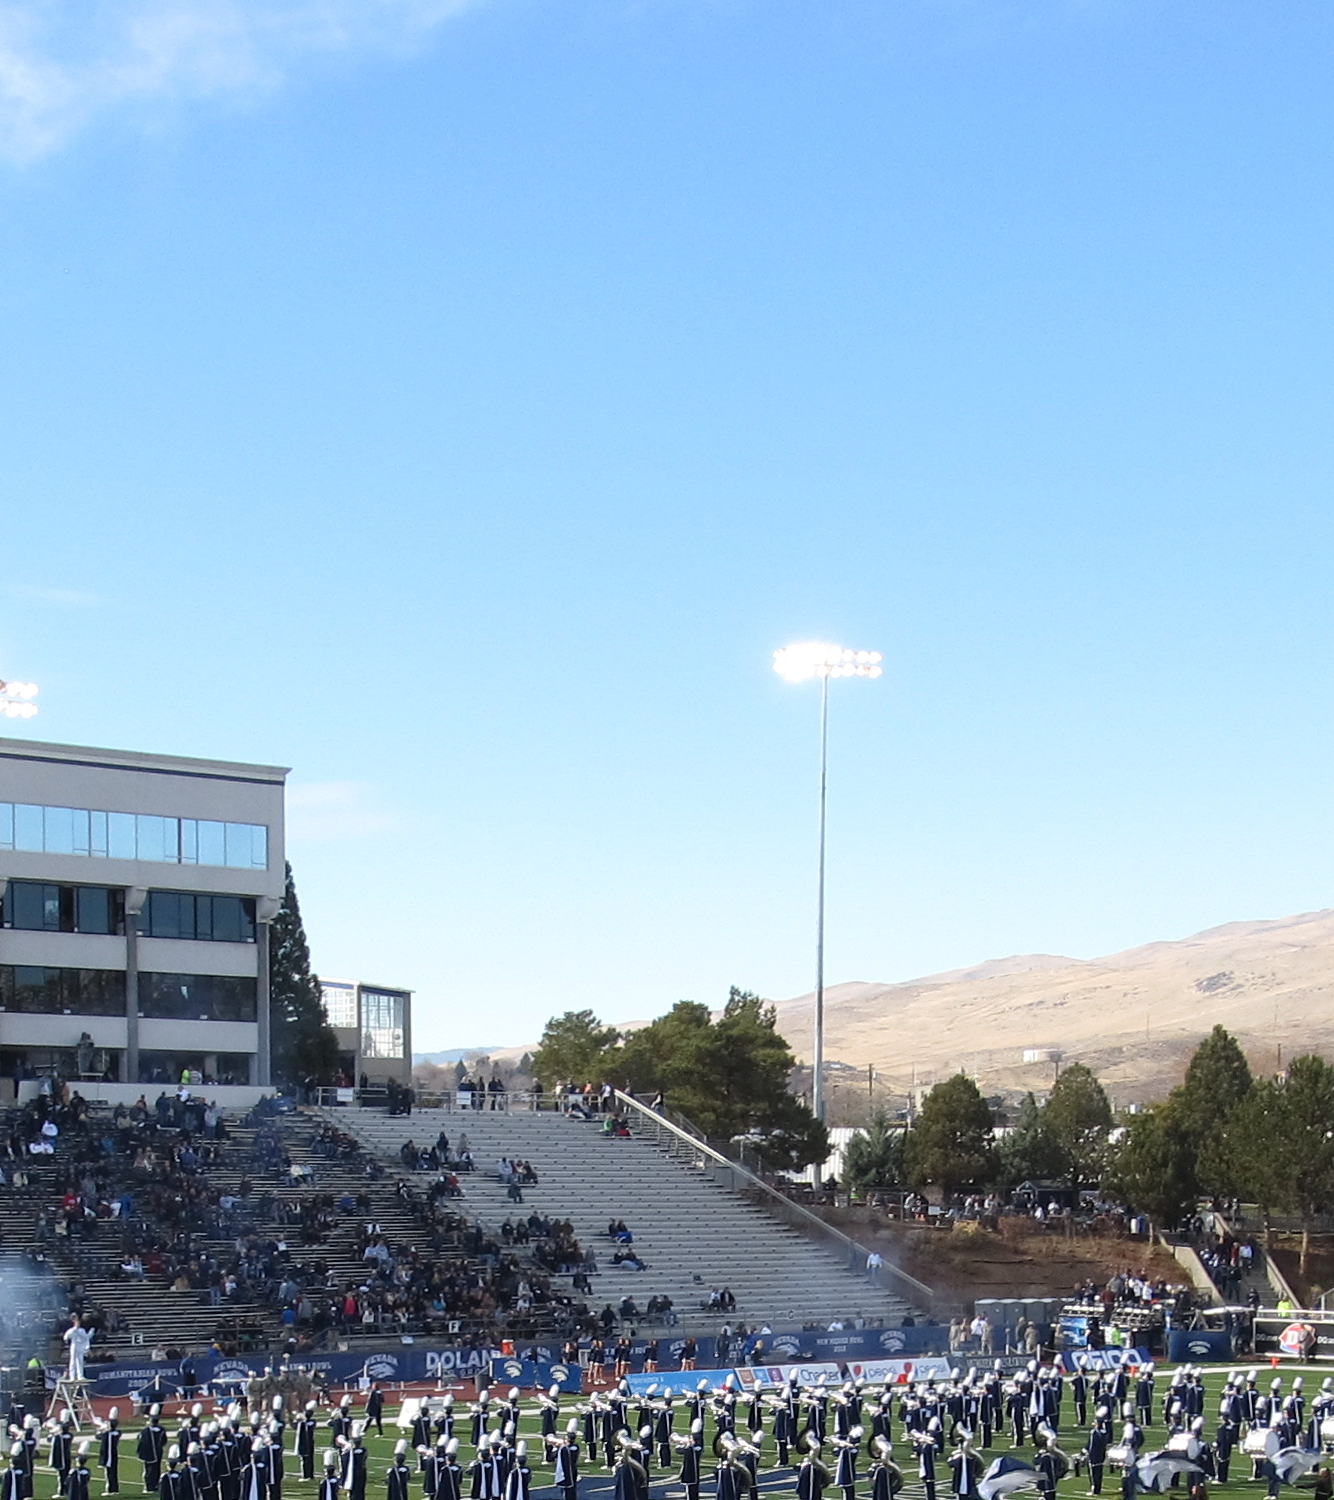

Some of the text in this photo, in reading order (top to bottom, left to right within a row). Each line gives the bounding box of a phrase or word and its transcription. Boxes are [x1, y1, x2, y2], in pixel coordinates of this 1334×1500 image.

[213, 1360, 249, 1374] NEVADA
[364, 1354, 399, 1367] NEVADA
[425, 1350, 493, 1370] DOLAN
